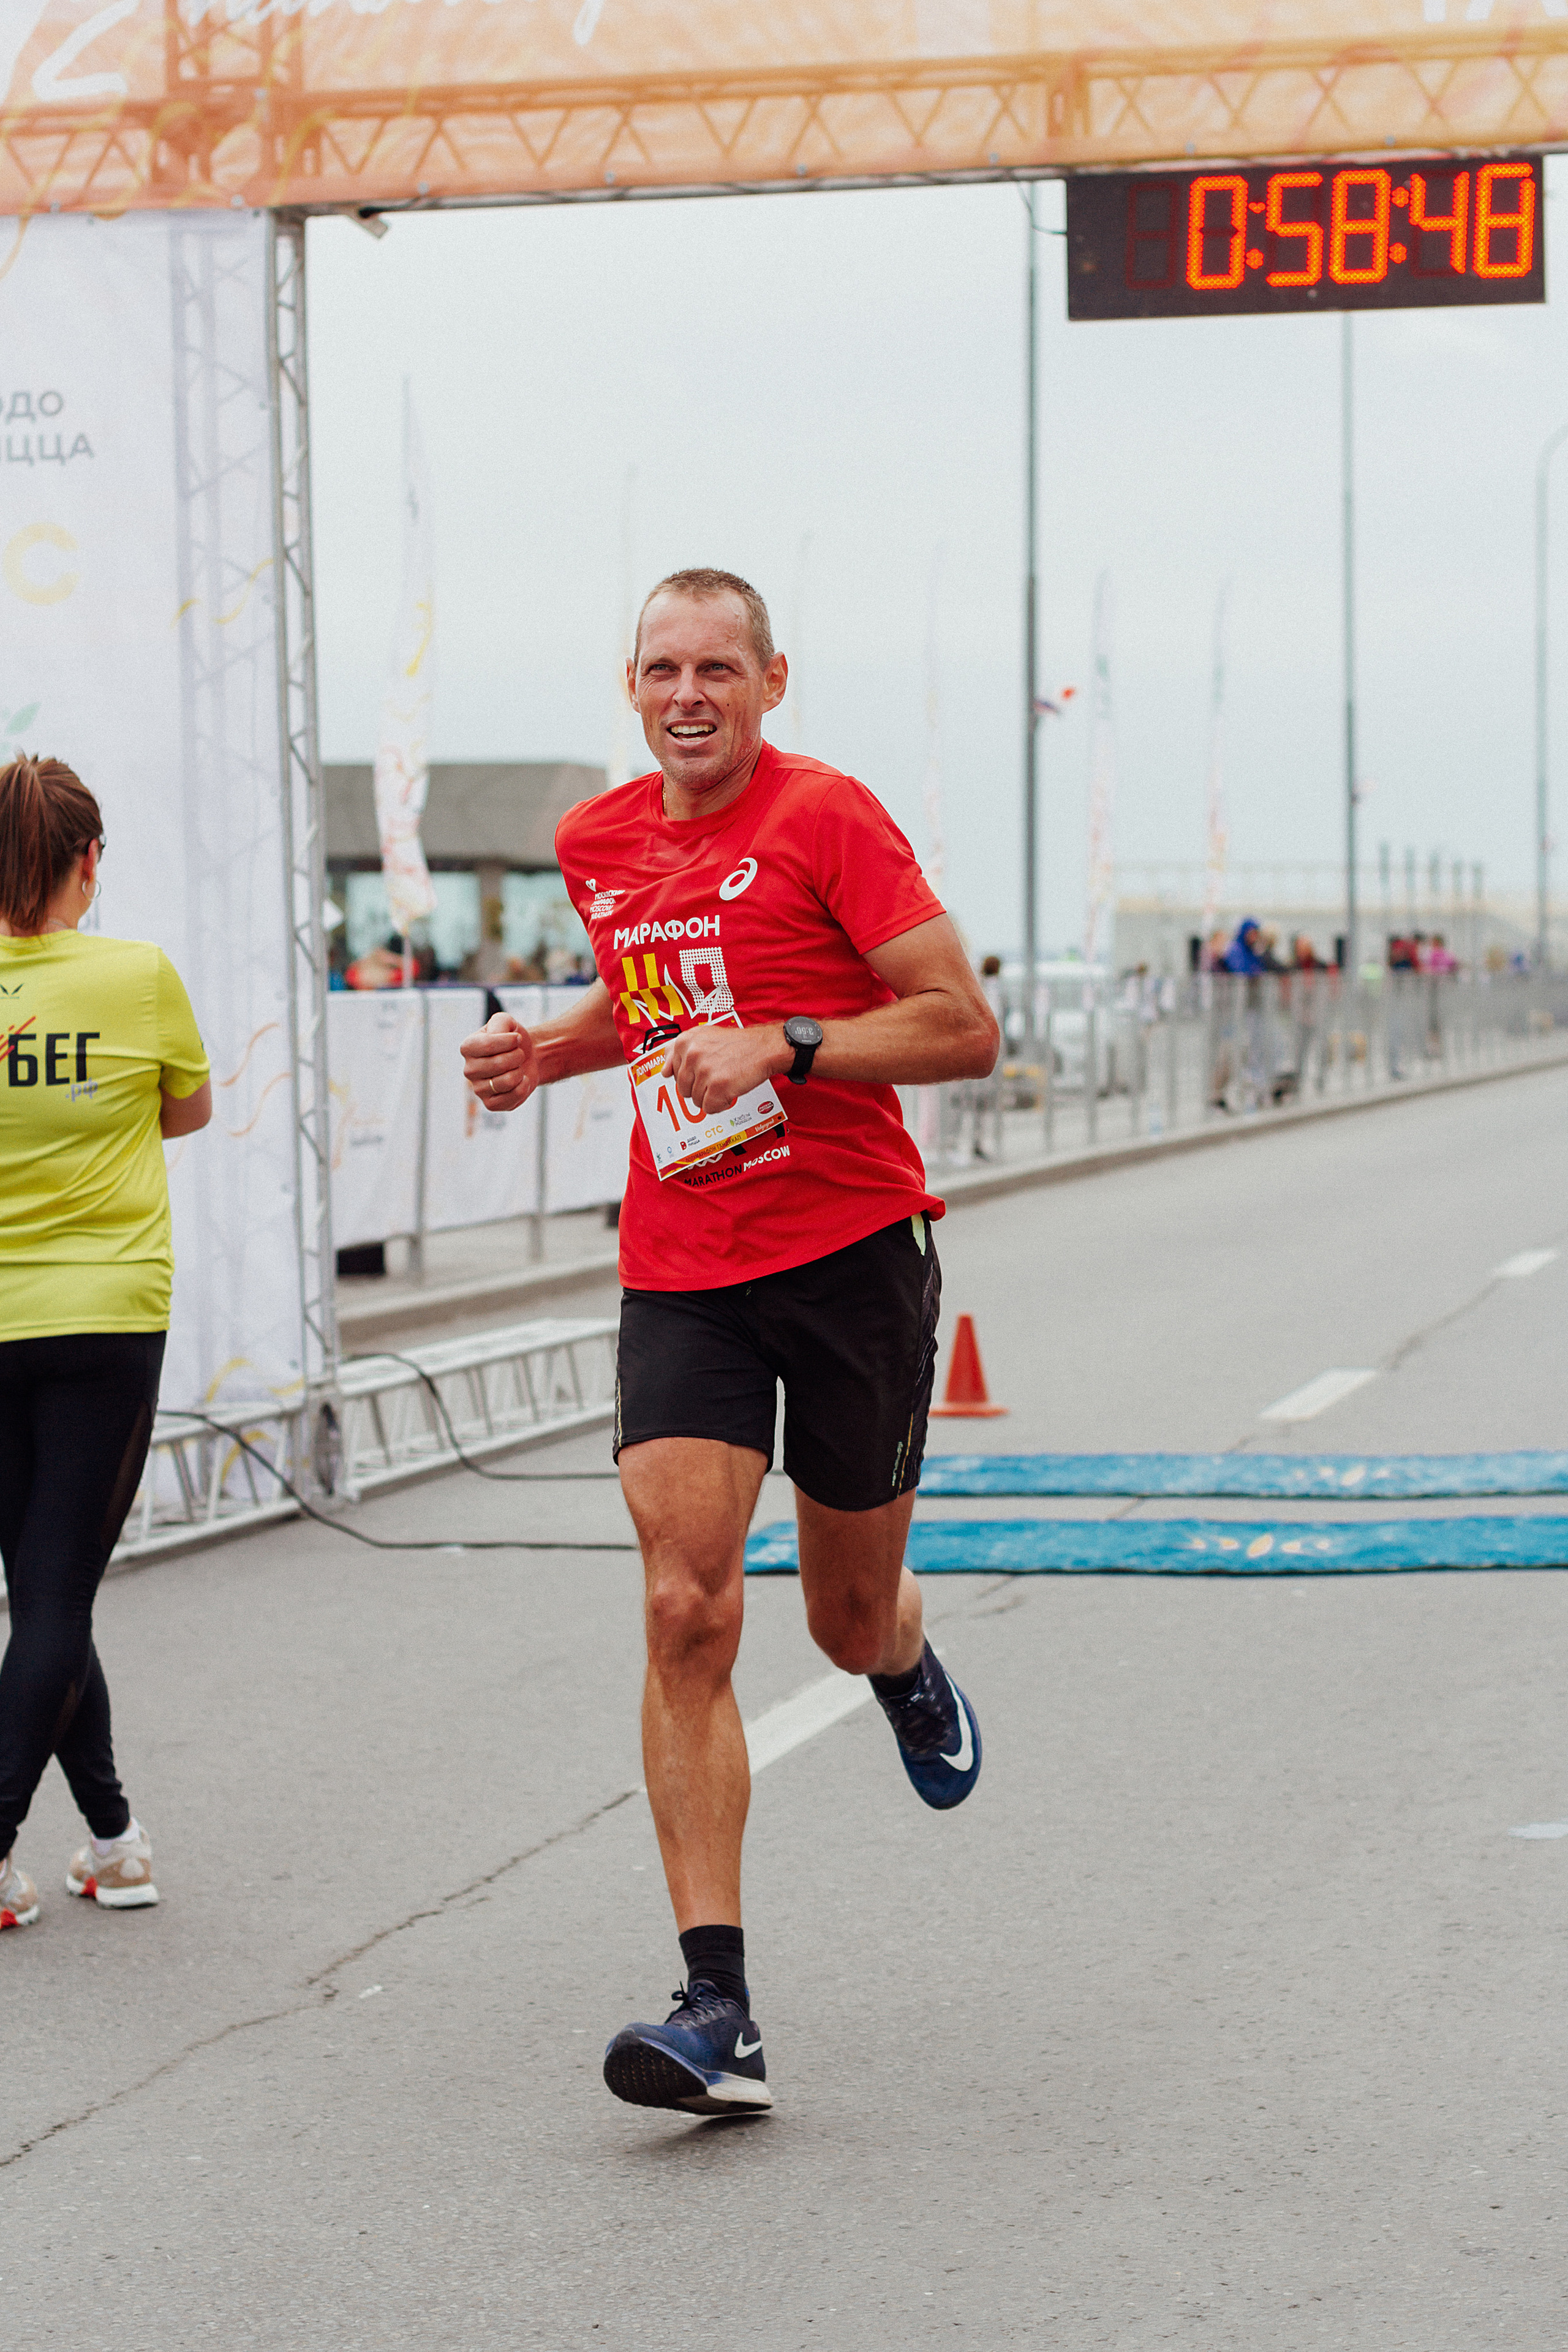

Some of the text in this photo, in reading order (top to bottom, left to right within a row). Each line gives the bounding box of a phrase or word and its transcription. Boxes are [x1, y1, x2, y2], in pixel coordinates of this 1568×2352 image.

[1186, 163, 1536, 290] 0:58:48
[0, 390, 64, 424] ДО
[0, 432, 94, 467] ЦЦА
[614, 915, 720, 949] МАРАФОН
[8, 1032, 100, 1087] БЕГ
[636, 1054, 666, 1077] ПОЛУМАРА
[684, 1164, 742, 1187] MARATHON
